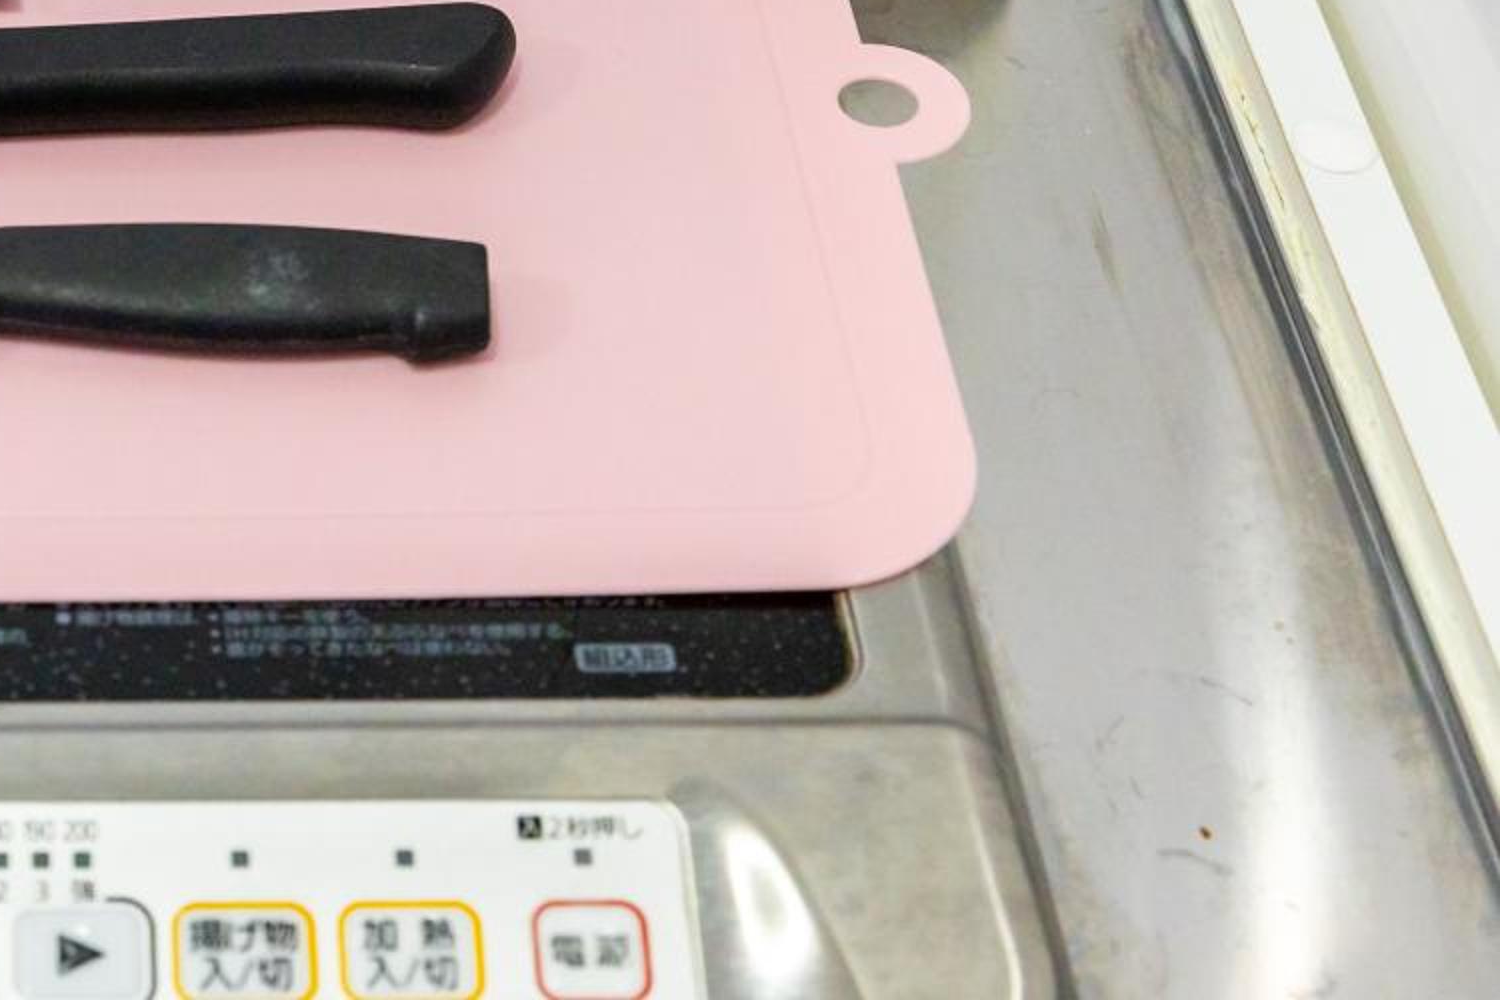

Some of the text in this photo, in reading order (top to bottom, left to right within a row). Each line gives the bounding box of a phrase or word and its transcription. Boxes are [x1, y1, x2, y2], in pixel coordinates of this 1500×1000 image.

[23, 820, 54, 843] 190
[63, 820, 98, 843] 200
[36, 880, 50, 902] 3
[189, 918, 299, 952] 揚げ物
[551, 934, 631, 967] 電源
[199, 955, 295, 992] 入/切
[367, 955, 460, 991] 入/切
